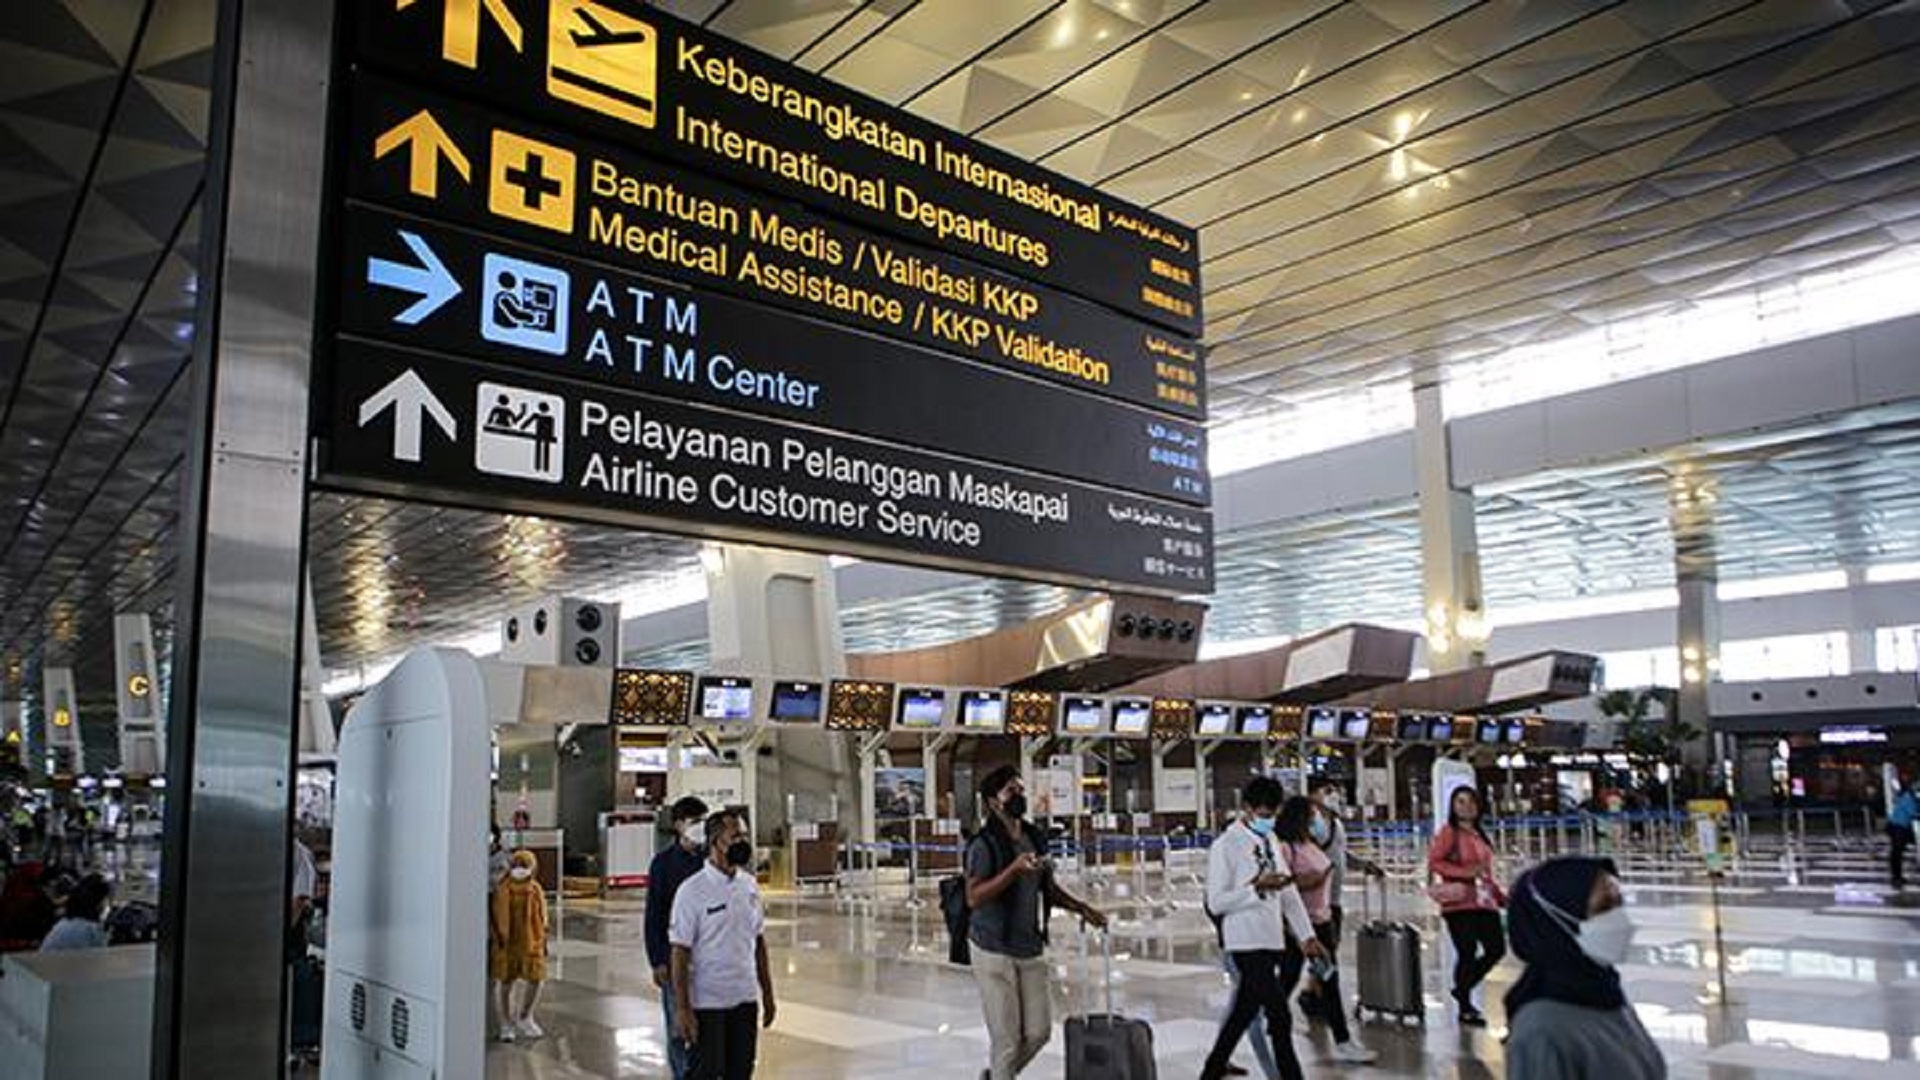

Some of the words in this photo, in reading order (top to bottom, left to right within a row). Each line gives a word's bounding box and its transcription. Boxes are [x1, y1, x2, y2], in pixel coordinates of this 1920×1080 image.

[677, 36, 926, 165] Keberangkatan
[935, 140, 1101, 232] Internasional
[677, 105, 886, 211] International
[895, 185, 1050, 268] Departures
[589, 206, 728, 276] Medical
[737, 252, 903, 324] Assistance
[932, 306, 991, 348] KKP
[995, 324, 1110, 385] Validation
[591, 159, 739, 235] Bantuan
[750, 208, 844, 266] Medis
[870, 244, 976, 305] Validasi
[982, 281, 1039, 322] KKP
[707, 354, 820, 408] Center
[580, 400, 771, 469] Pelayanan
[782, 438, 941, 500] Pelanggan
[949, 470, 1069, 524] Maskapai
[580, 452, 699, 504] Airline
[709, 473, 870, 528] Customer
[876, 500, 981, 547] Service
[129, 674, 149, 696] C
